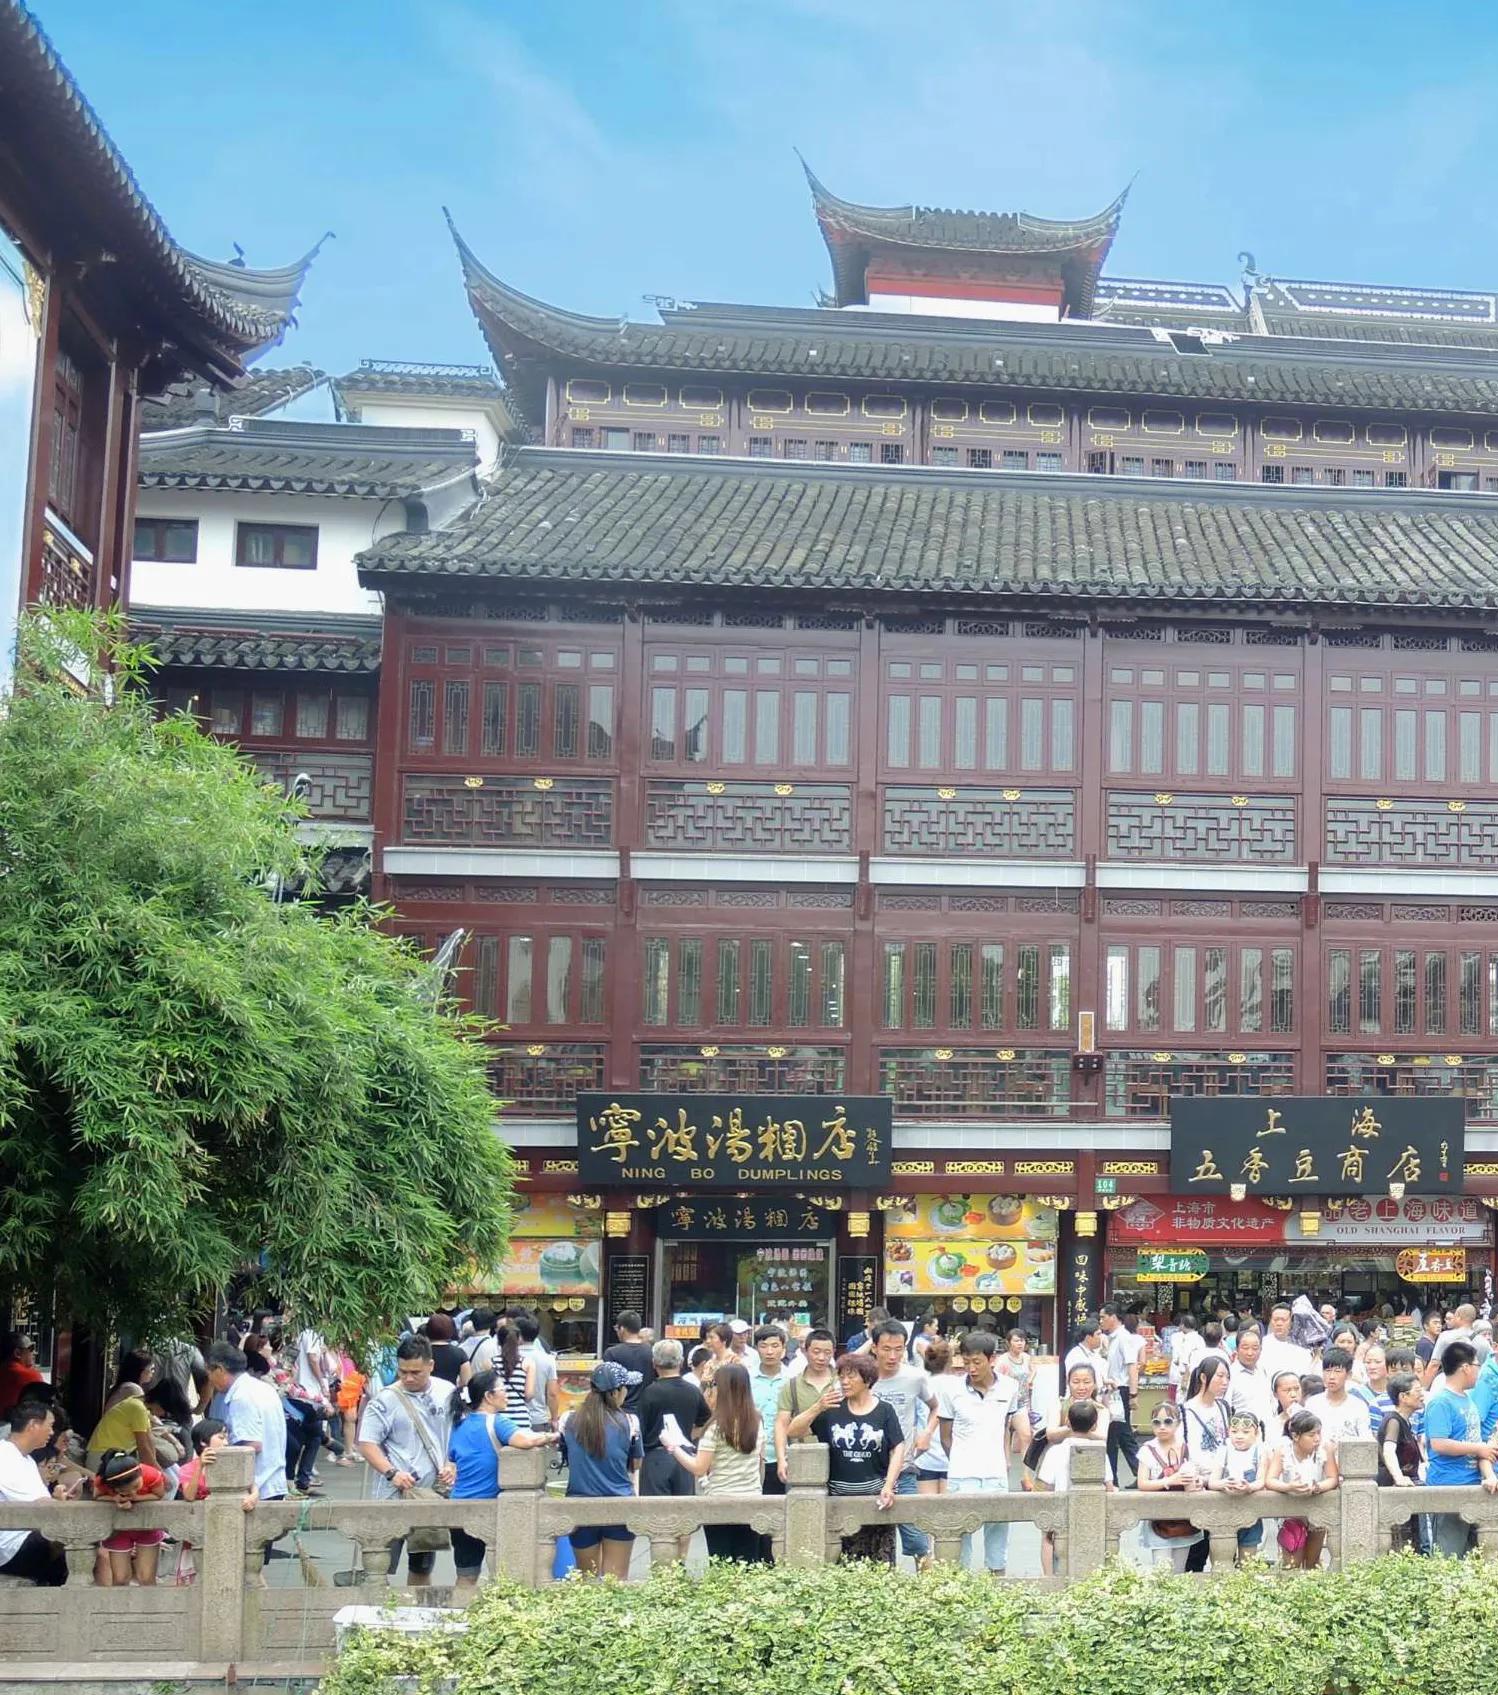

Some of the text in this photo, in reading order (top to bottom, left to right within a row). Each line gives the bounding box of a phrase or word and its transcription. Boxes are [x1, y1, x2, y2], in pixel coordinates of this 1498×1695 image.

[1256, 1105, 1382, 1138] 上海
[1188, 1145, 1422, 1184] 五香豆商店
[621, 1167, 843, 1181] NING BO DUMPLINGS
[1098, 1180, 1114, 1189] 104
[1172, 1201, 1216, 1215] 上海市
[1322, 1199, 1480, 1222] 品老上海味道
[1172, 1217, 1275, 1231] 非物质文化遗产
[1337, 1227, 1466, 1235] OLD SHANGHAI FLAVOR
